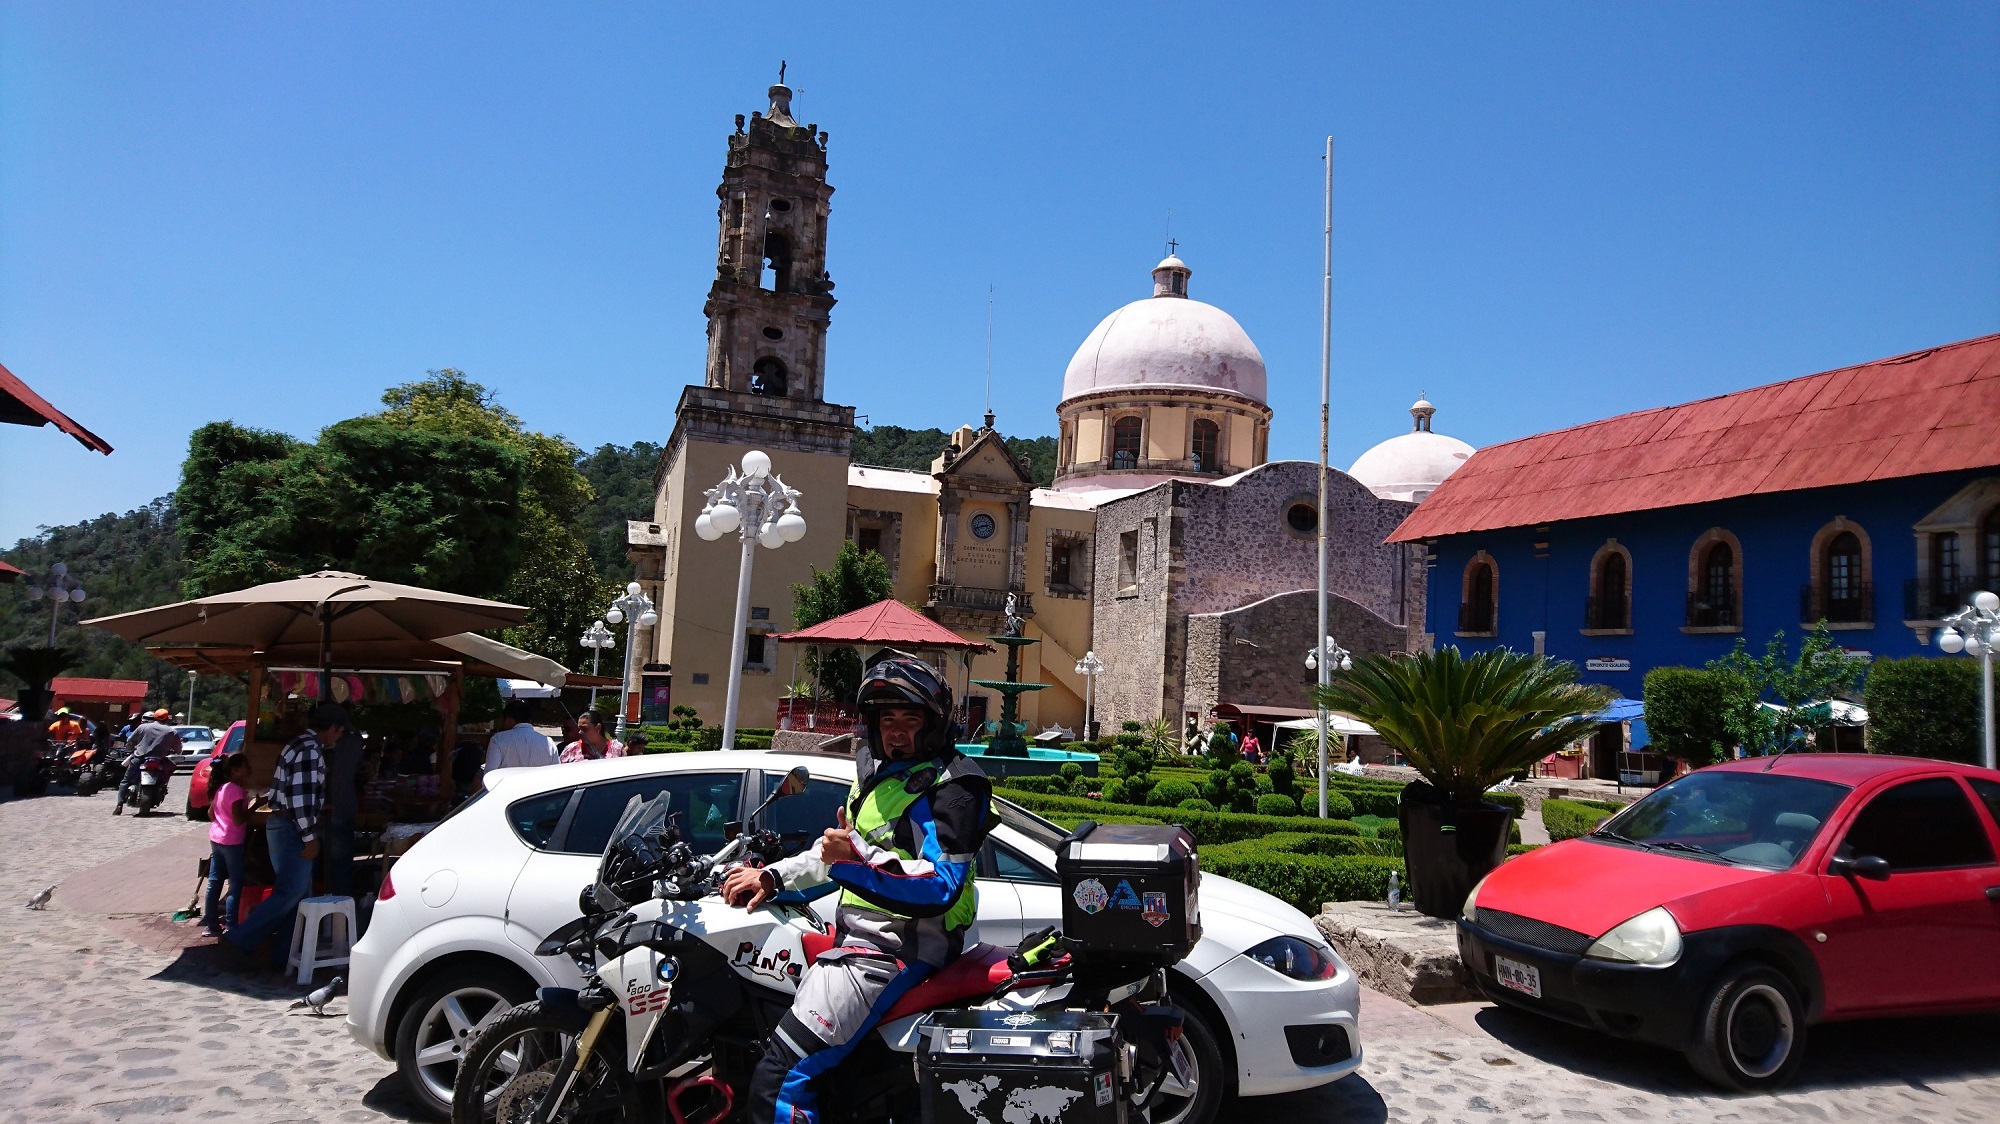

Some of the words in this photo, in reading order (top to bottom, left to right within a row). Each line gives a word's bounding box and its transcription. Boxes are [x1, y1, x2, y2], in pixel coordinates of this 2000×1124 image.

[627, 978, 637, 993] F
[631, 984, 651, 996] 800
[628, 988, 669, 1016] GS
